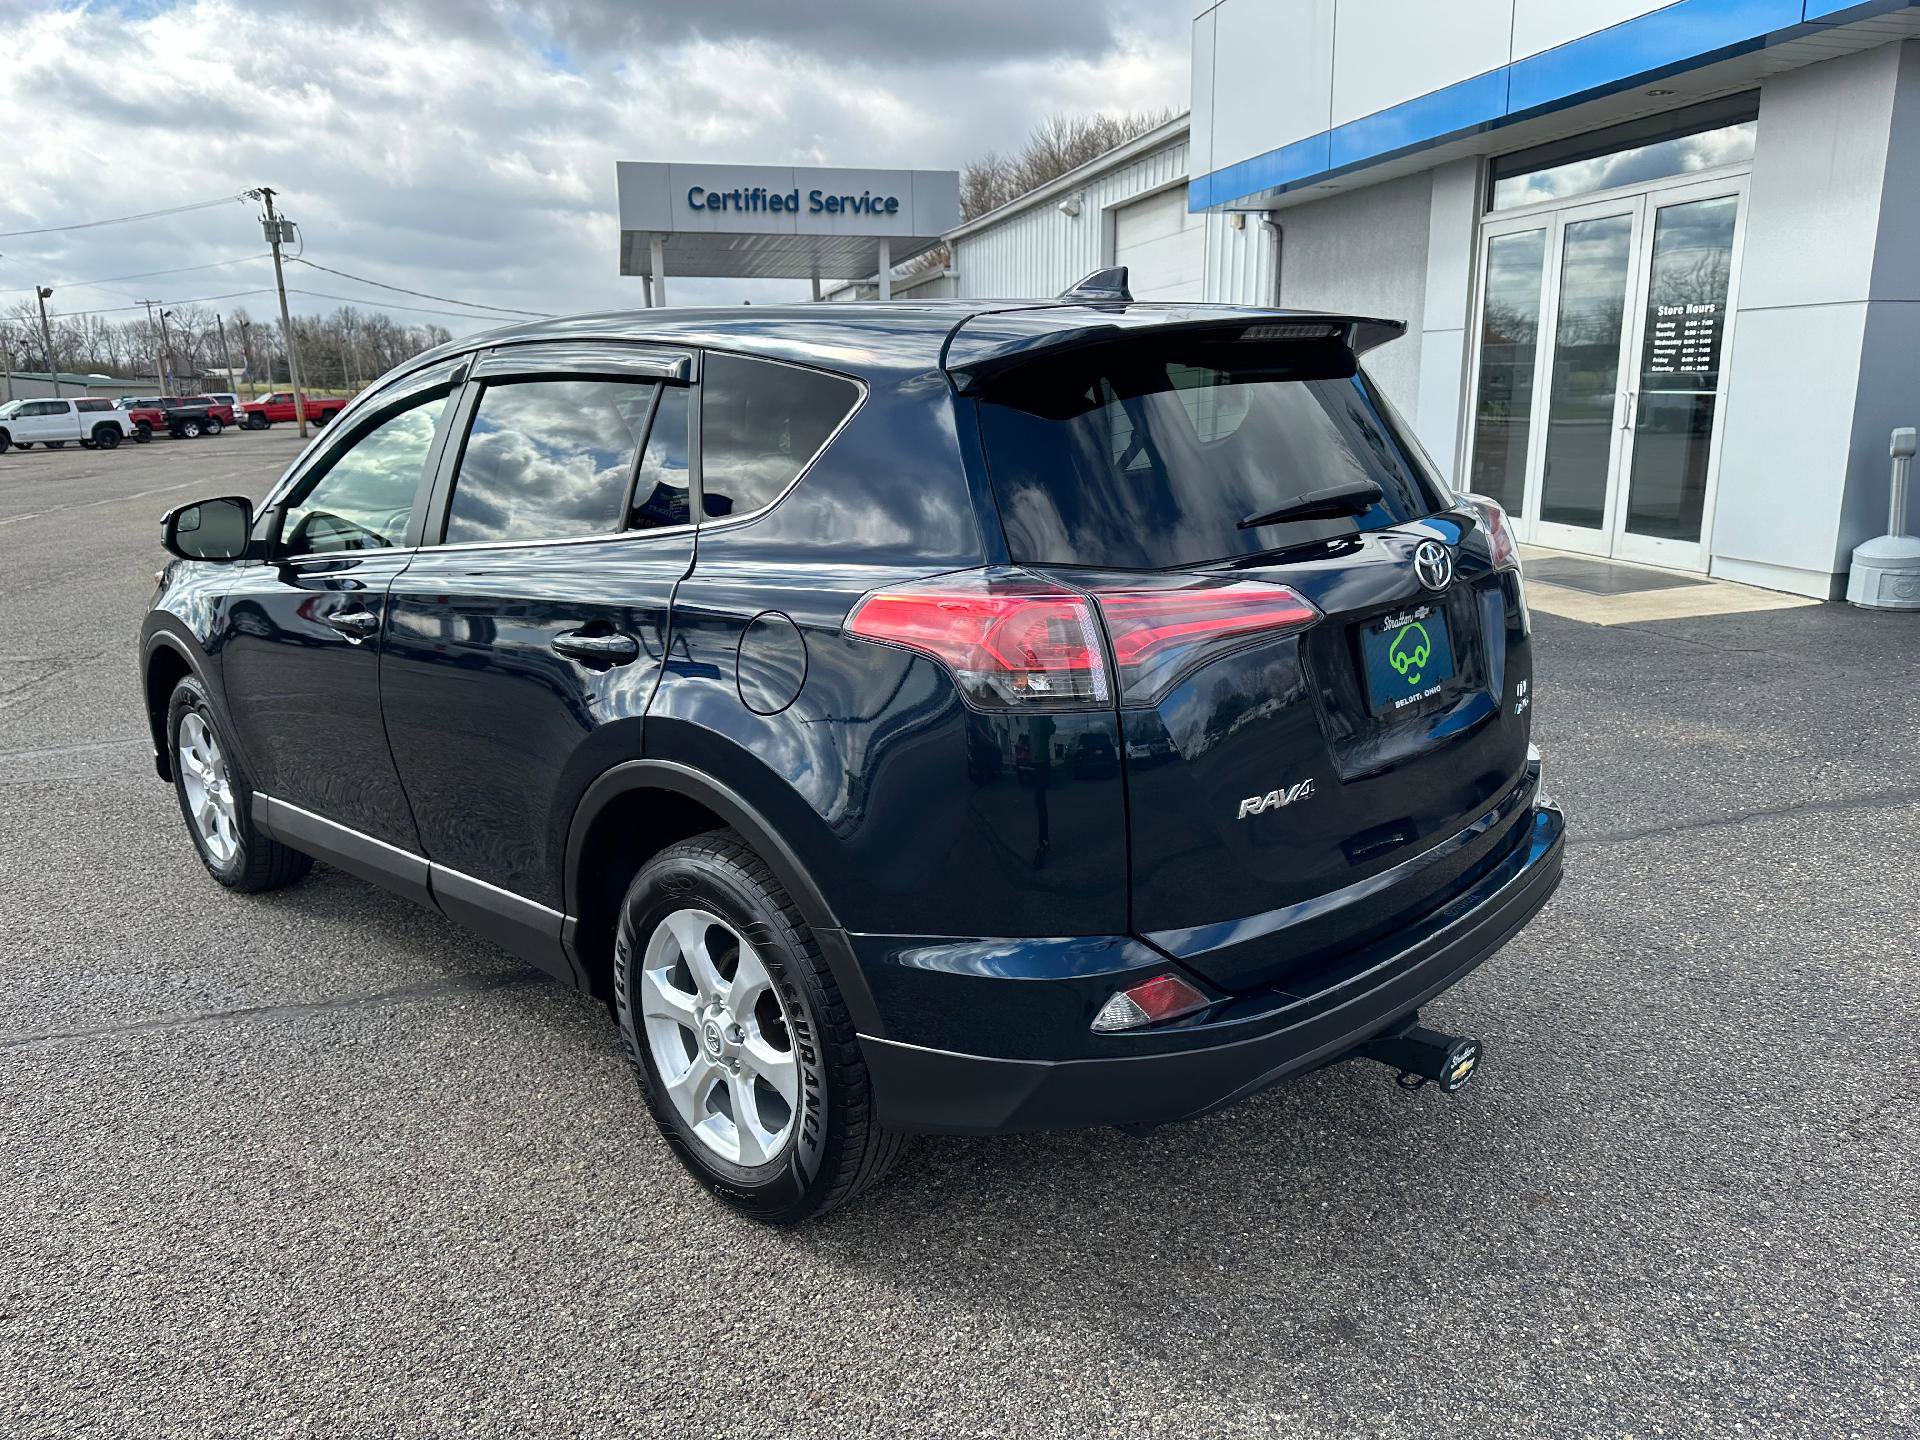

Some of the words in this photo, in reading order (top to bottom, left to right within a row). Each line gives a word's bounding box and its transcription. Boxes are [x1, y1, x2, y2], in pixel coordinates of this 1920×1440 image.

[687, 186, 799, 213] Certified
[809, 190, 899, 215] Service
[1658, 305, 1683, 316] Store
[1686, 303, 1715, 314] Hours
[1383, 611, 1414, 631] Stratton
[1424, 685, 1442, 697] OHIO
[1238, 779, 1315, 820] RAV4
[772, 962, 820, 1153] ASSURANCE
